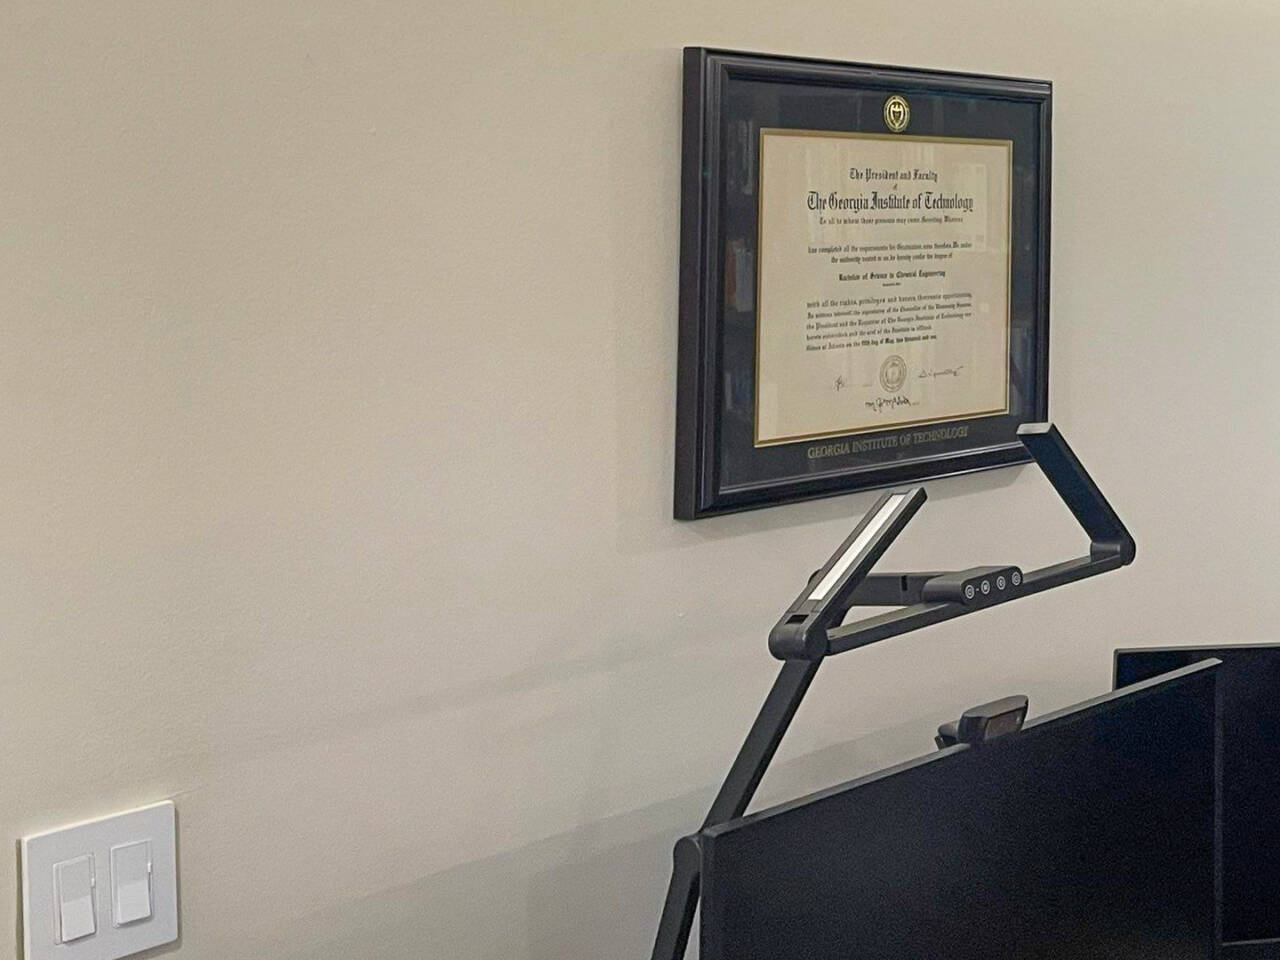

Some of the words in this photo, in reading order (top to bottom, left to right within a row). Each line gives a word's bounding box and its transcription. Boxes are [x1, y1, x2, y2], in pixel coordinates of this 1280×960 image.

[850, 168, 863, 180] The
[866, 168, 898, 182] President
[900, 170, 911, 180] and
[913, 168, 938, 183] Faculty
[807, 191, 827, 212] The
[828, 192, 869, 213] Georgia
[870, 191, 910, 210] Institute
[912, 193, 923, 210] of
[924, 192, 974, 212] Technology
[807, 444, 850, 459] GEORGIA
[852, 436, 898, 453] INSTITUTE
[901, 434, 912, 445] OF
[913, 426, 969, 444] TECHNOLOGY
